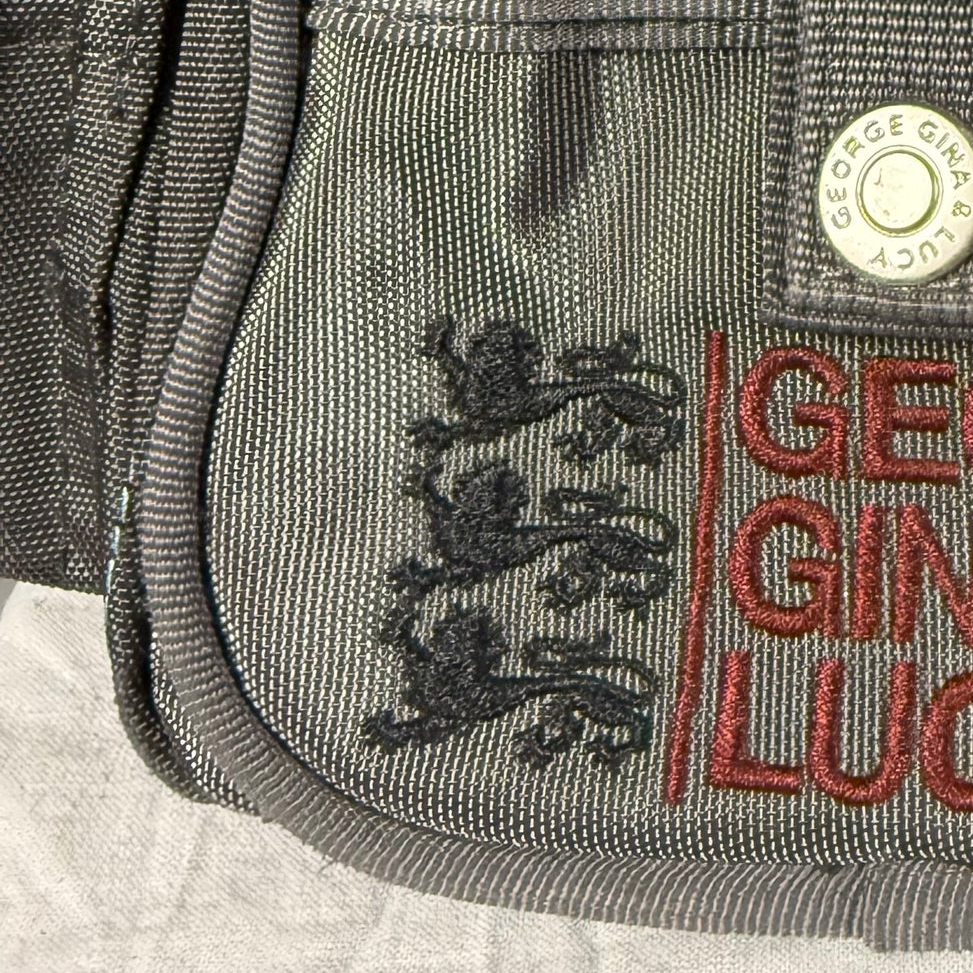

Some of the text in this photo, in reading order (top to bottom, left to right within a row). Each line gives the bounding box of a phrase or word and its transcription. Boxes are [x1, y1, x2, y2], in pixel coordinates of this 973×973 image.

[826, 114, 904, 230] GEORGE
[917, 119, 972, 191] GINA
[867, 226, 956, 270] LUCY
